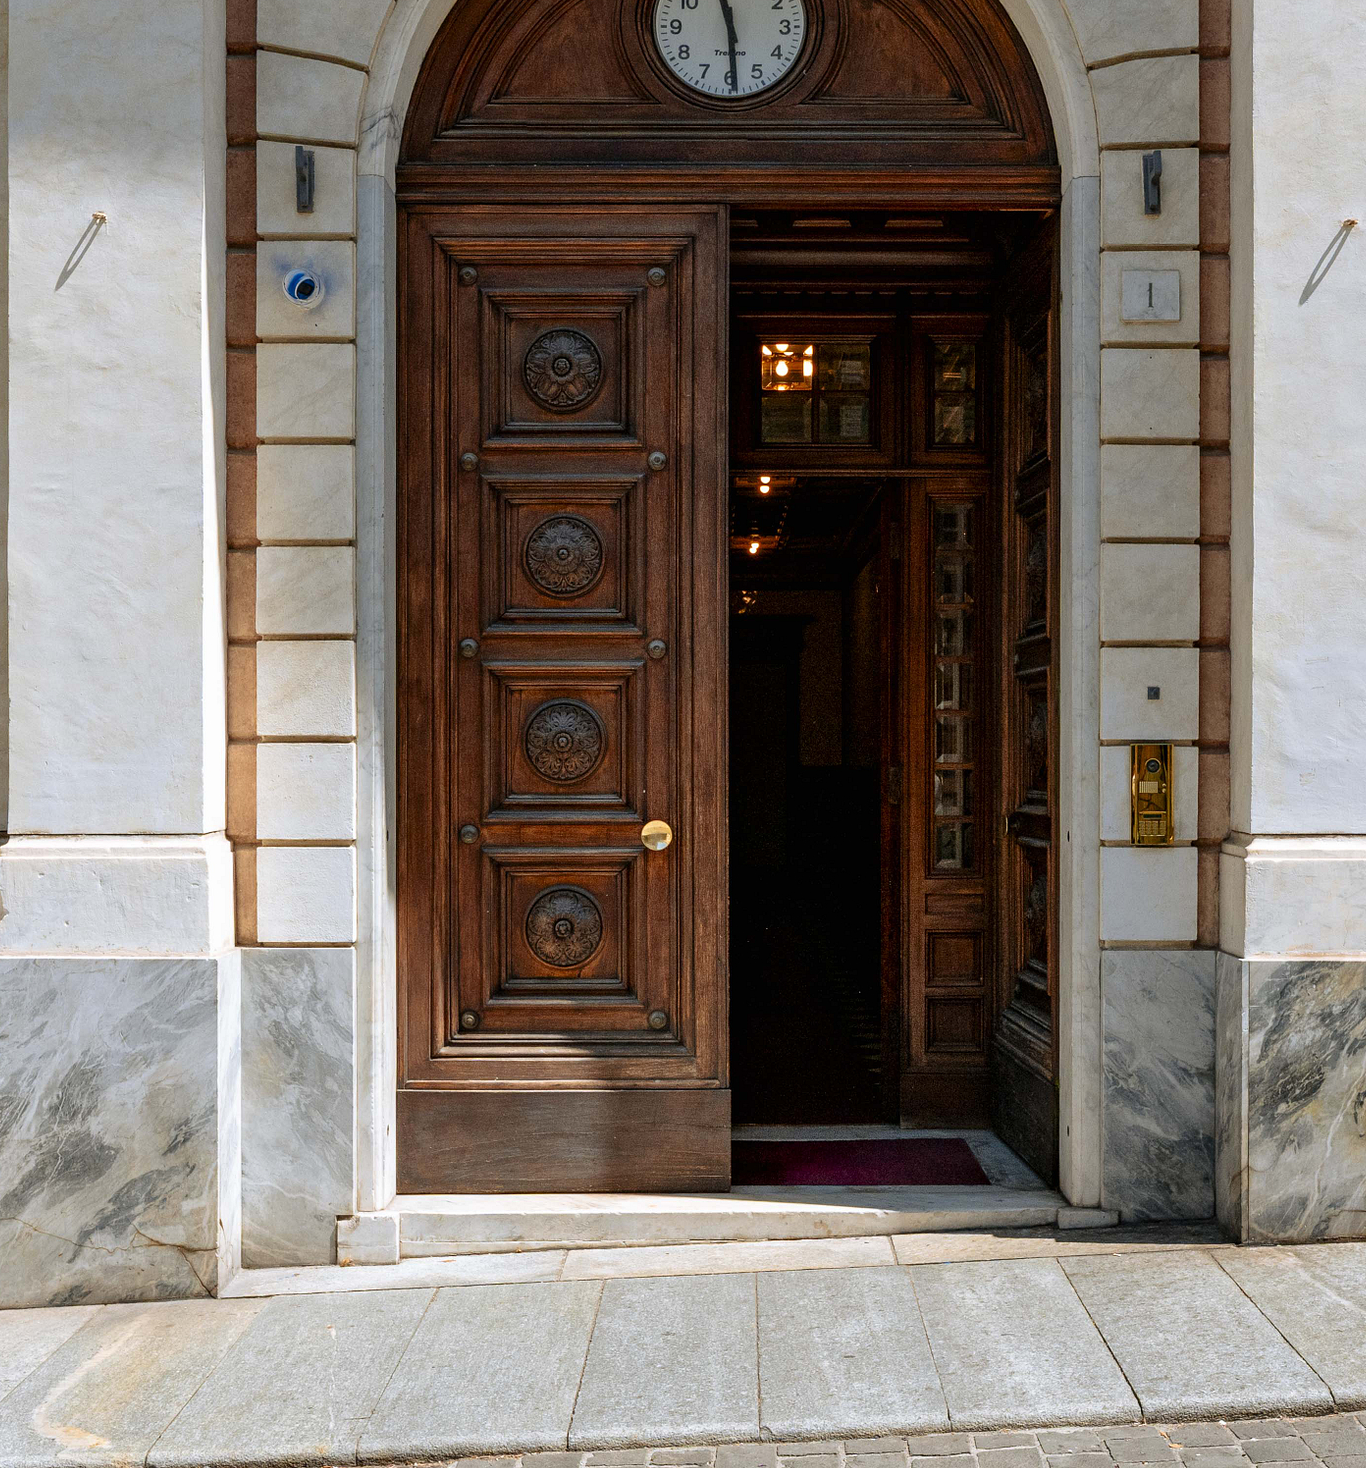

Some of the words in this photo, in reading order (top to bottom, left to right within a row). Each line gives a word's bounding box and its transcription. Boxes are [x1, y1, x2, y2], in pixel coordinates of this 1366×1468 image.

[669, 19, 682, 35] 9
[778, 19, 791, 35] 3
[678, 45, 690, 60] 8
[770, 45, 783, 60] 4
[698, 64, 711, 79] 7
[750, 64, 763, 79] 5
[1147, 282, 1154, 308] 1
